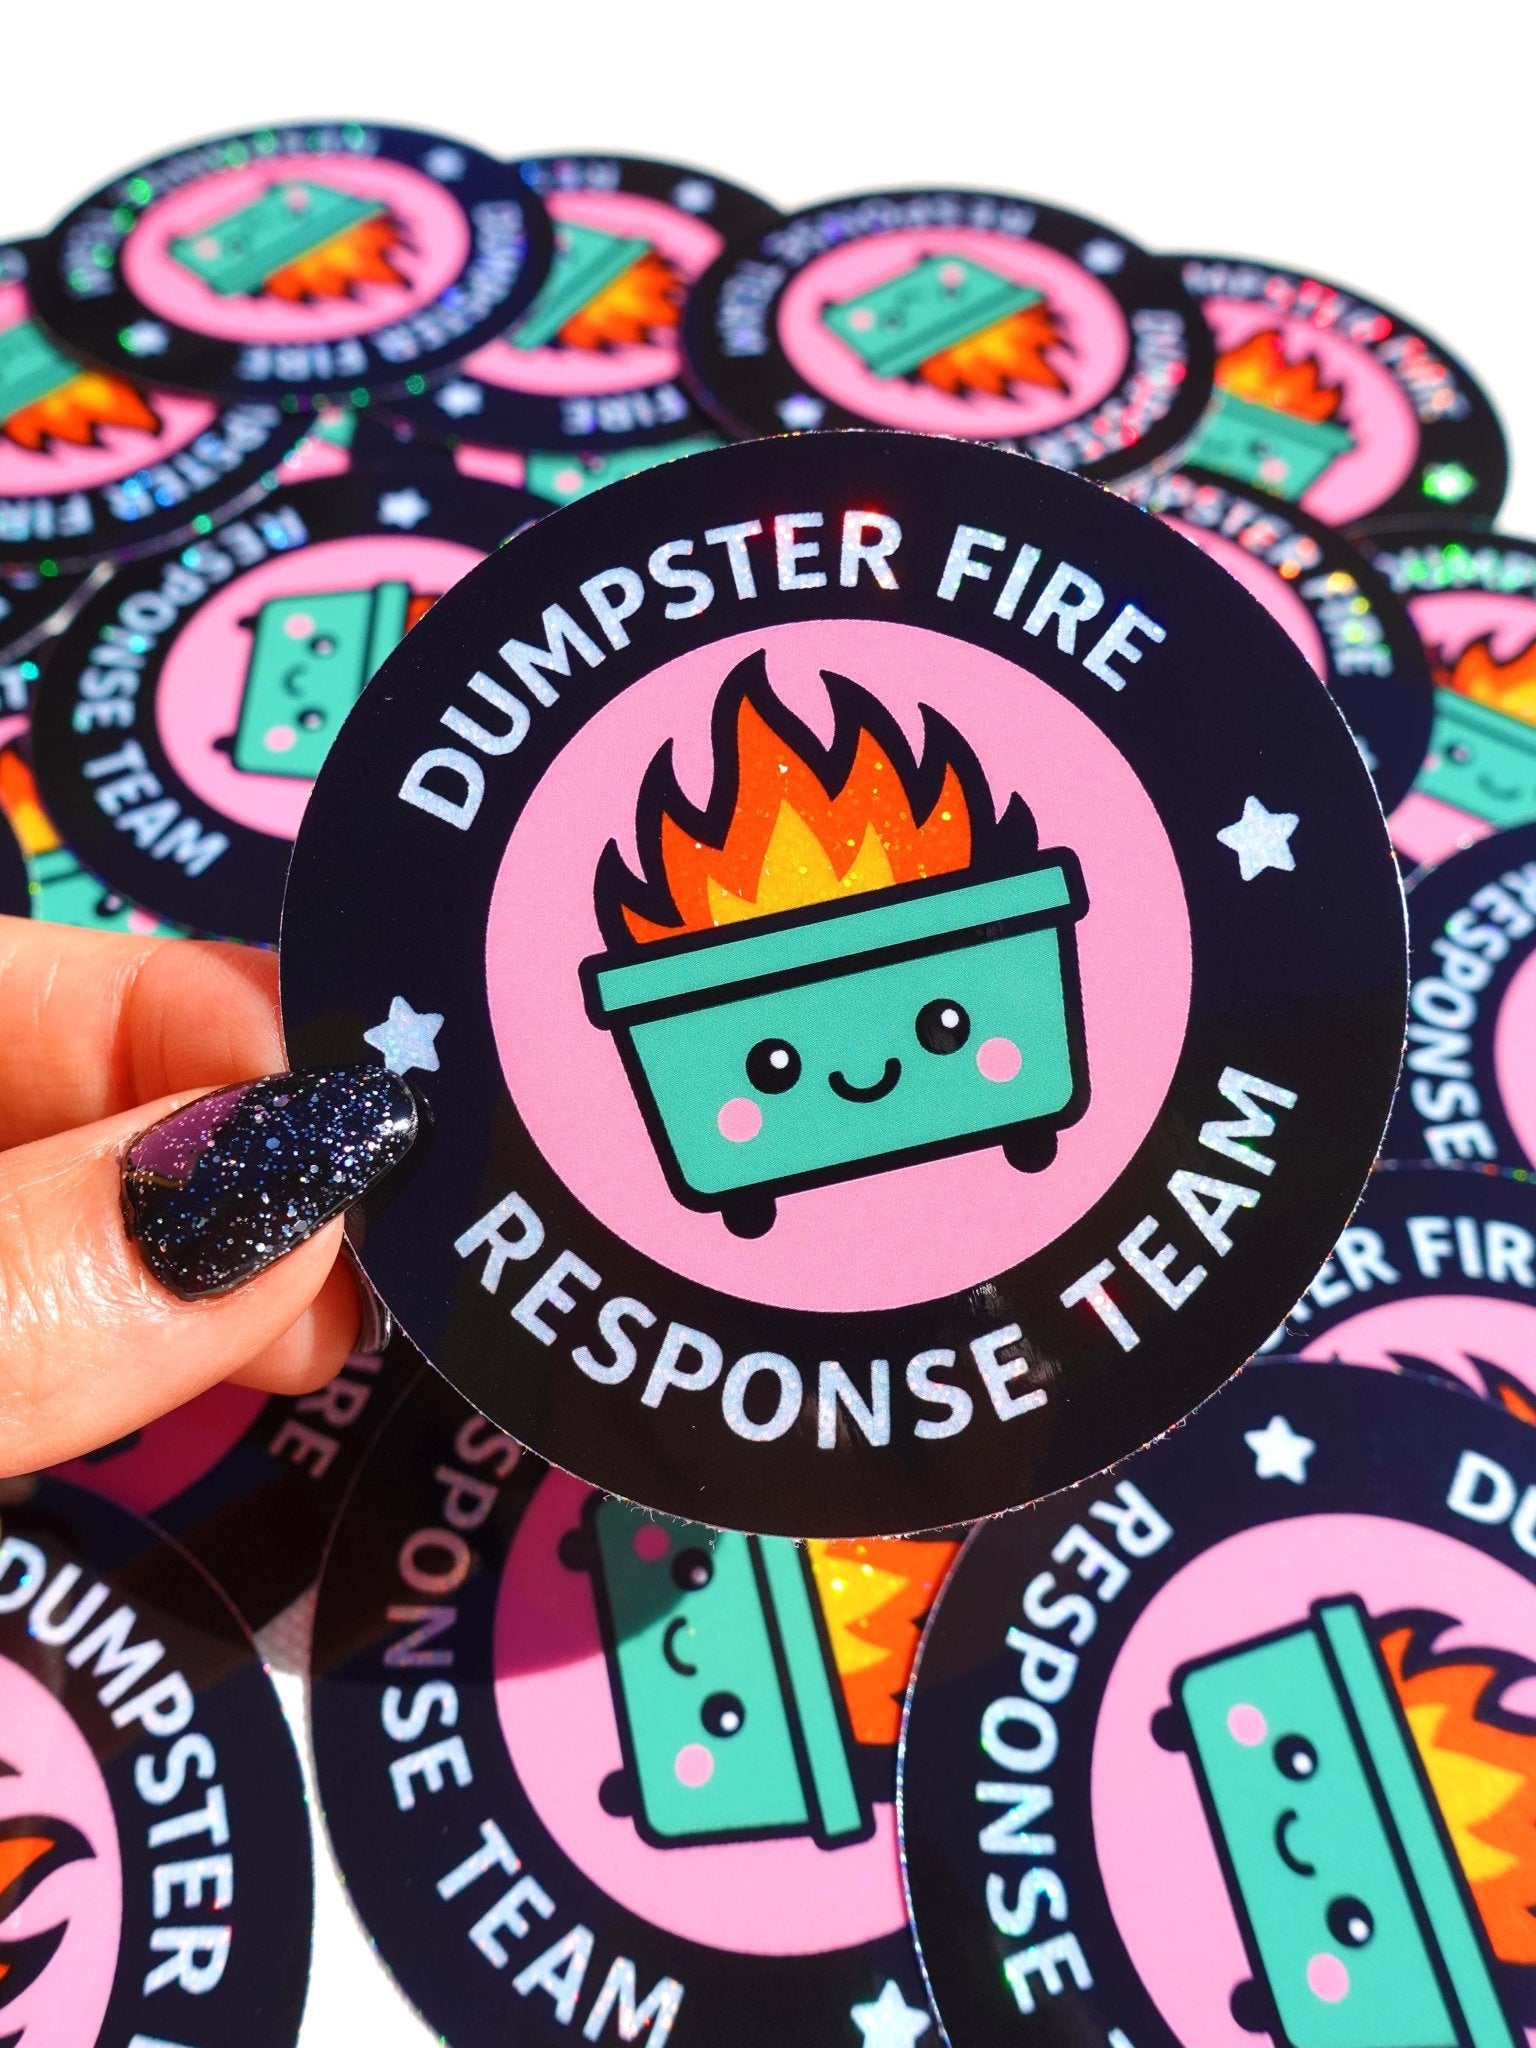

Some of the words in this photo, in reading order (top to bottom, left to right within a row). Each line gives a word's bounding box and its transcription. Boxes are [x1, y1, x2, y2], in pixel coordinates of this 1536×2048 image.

[72, 505, 308, 735] RESPONSE
[399, 510, 902, 832] DUMPSTER
[937, 524, 1167, 692] FIRE
[82, 738, 230, 878] TEAM
[454, 1191, 1049, 1451] RESPONSE
[1059, 1066, 1299, 1354] TEAM
[0, 1536, 234, 1996] DUMPSTER
[974, 1478, 1174, 2015] RESPONSE
[436, 1818, 685, 2048] TEAM
